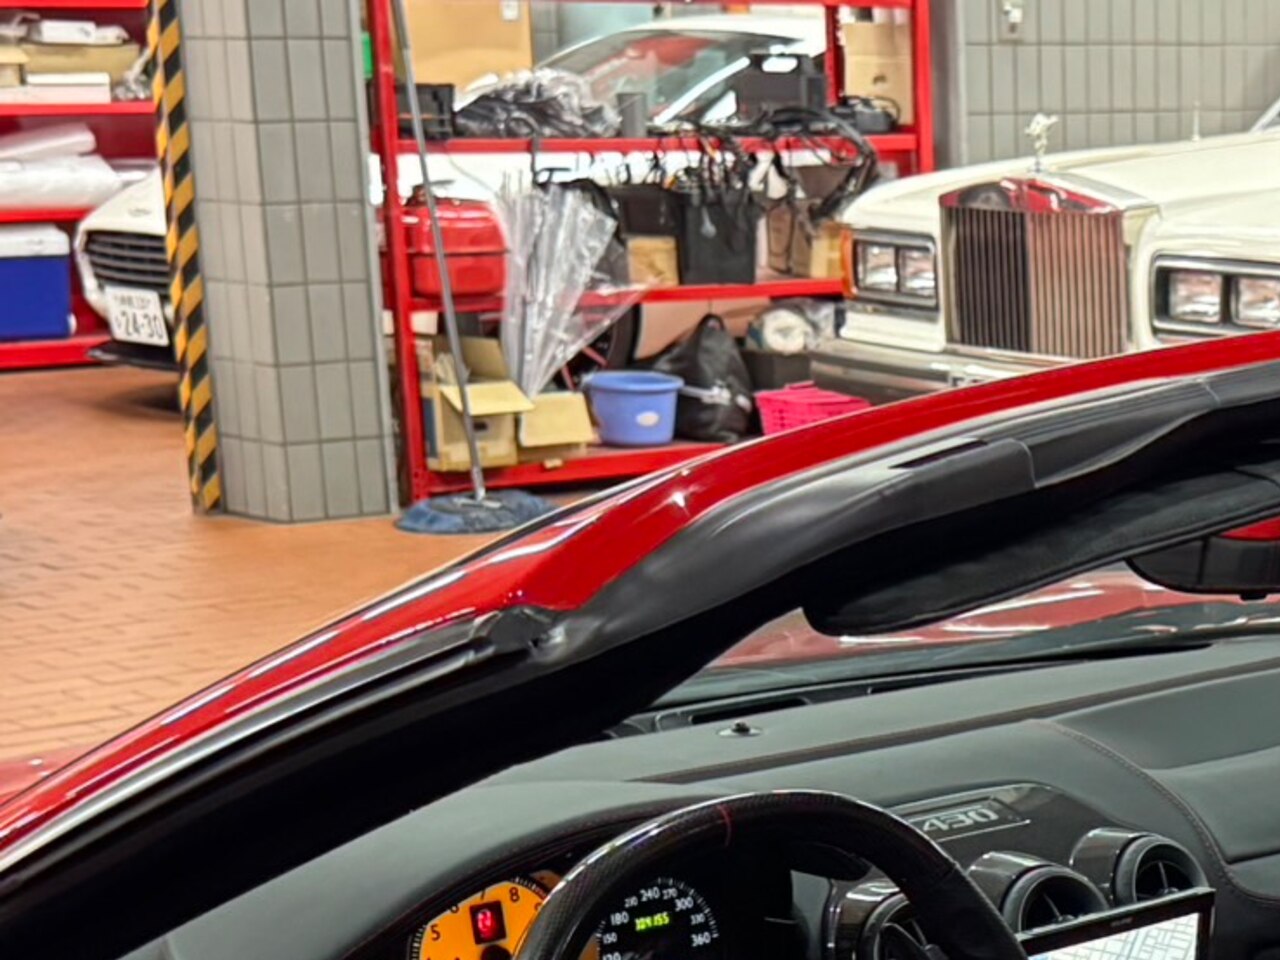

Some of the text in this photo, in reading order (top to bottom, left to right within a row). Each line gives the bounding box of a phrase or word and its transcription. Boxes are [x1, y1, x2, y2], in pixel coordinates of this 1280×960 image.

[912, 804, 999, 832] 430
[509, 886, 520, 902] 8
[639, 886, 660, 902] 240
[674, 897, 694, 912] 300
[610, 911, 629, 926] 180
[430, 924, 441, 941] 5
[603, 932, 617, 944] 150
[691, 932, 711, 947] 360
